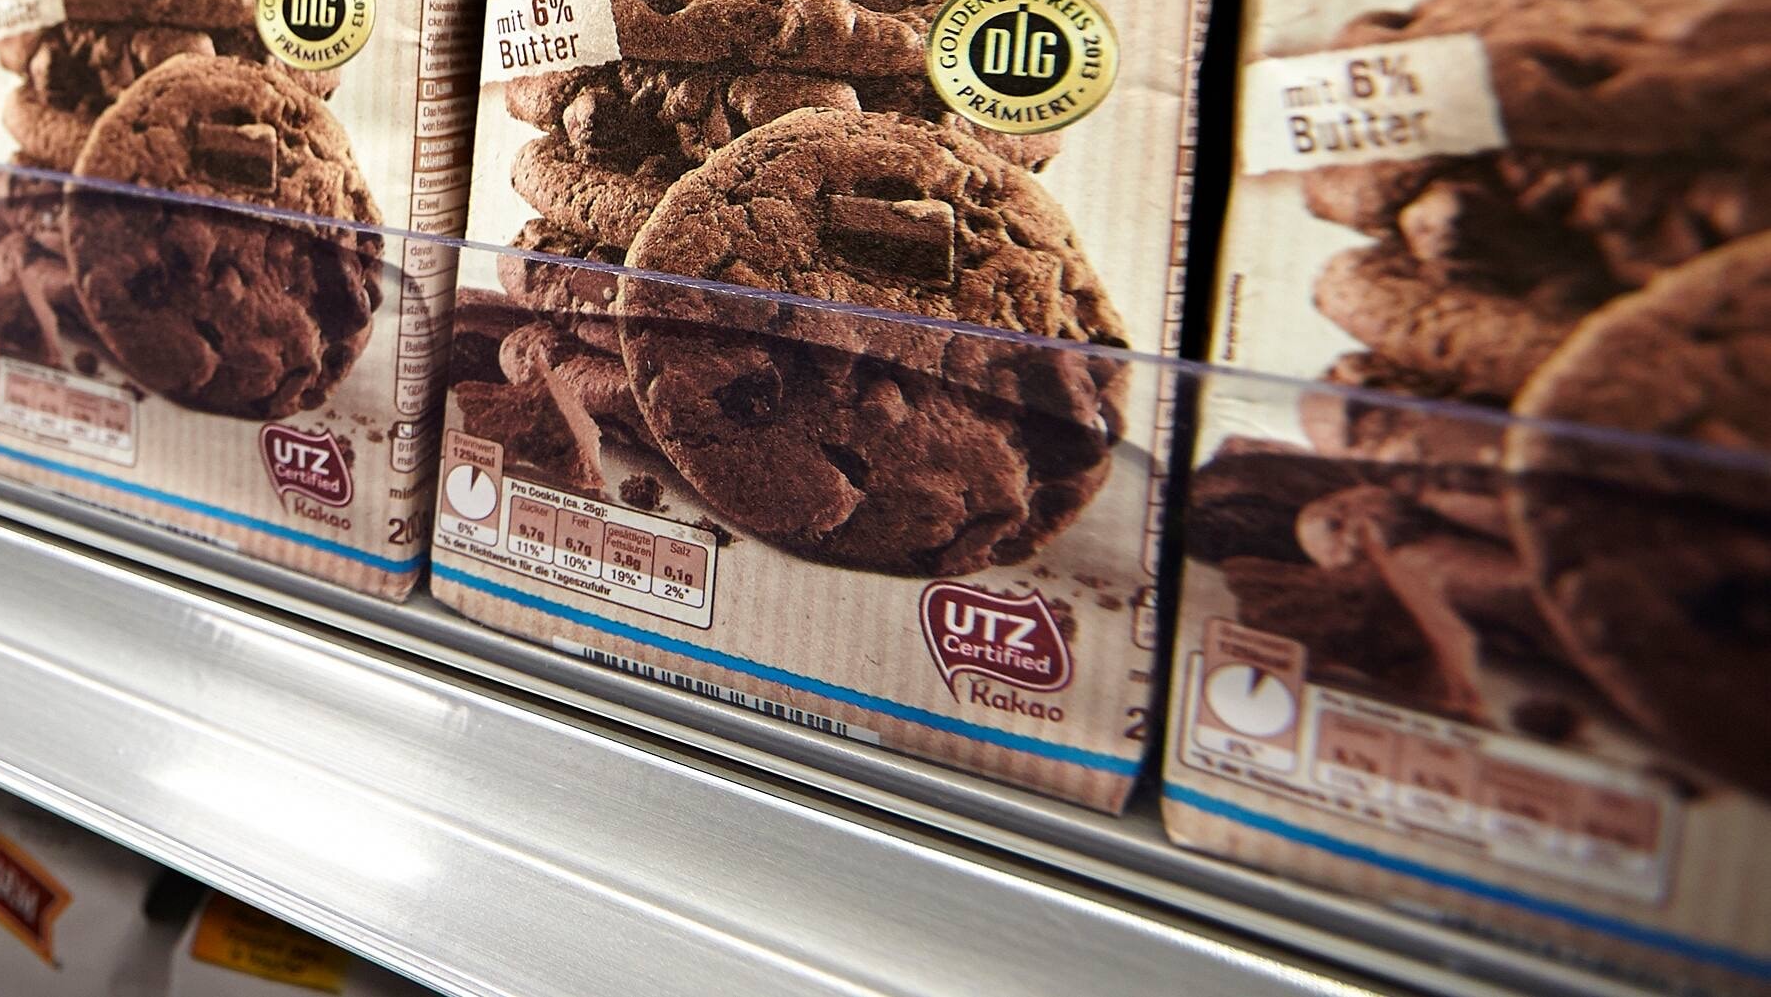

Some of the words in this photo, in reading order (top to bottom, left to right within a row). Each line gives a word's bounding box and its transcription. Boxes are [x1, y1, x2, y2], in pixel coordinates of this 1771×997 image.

[495, 8, 526, 35] mit
[982, 3, 1059, 79] DLG
[497, 28, 580, 72] Butter
[1081, 34, 1102, 81] 2013
[1281, 76, 1339, 111] mit
[1346, 51, 1420, 102] 6%
[956, 85, 1078, 123] PRÄMIERT
[1288, 106, 1430, 155] Butter
[272, 435, 330, 477] UTZ
[452, 446, 496, 467] 125kcal
[274, 461, 342, 495] Certified
[293, 497, 353, 532] Kakao
[565, 537, 593, 557] 6,7g
[669, 542, 692, 558] Salz
[664, 564, 694, 587] 0,1g
[943, 600, 1038, 652] UTZ
[942, 634, 1052, 675] Certified
[969, 678, 1065, 723] Kakao
